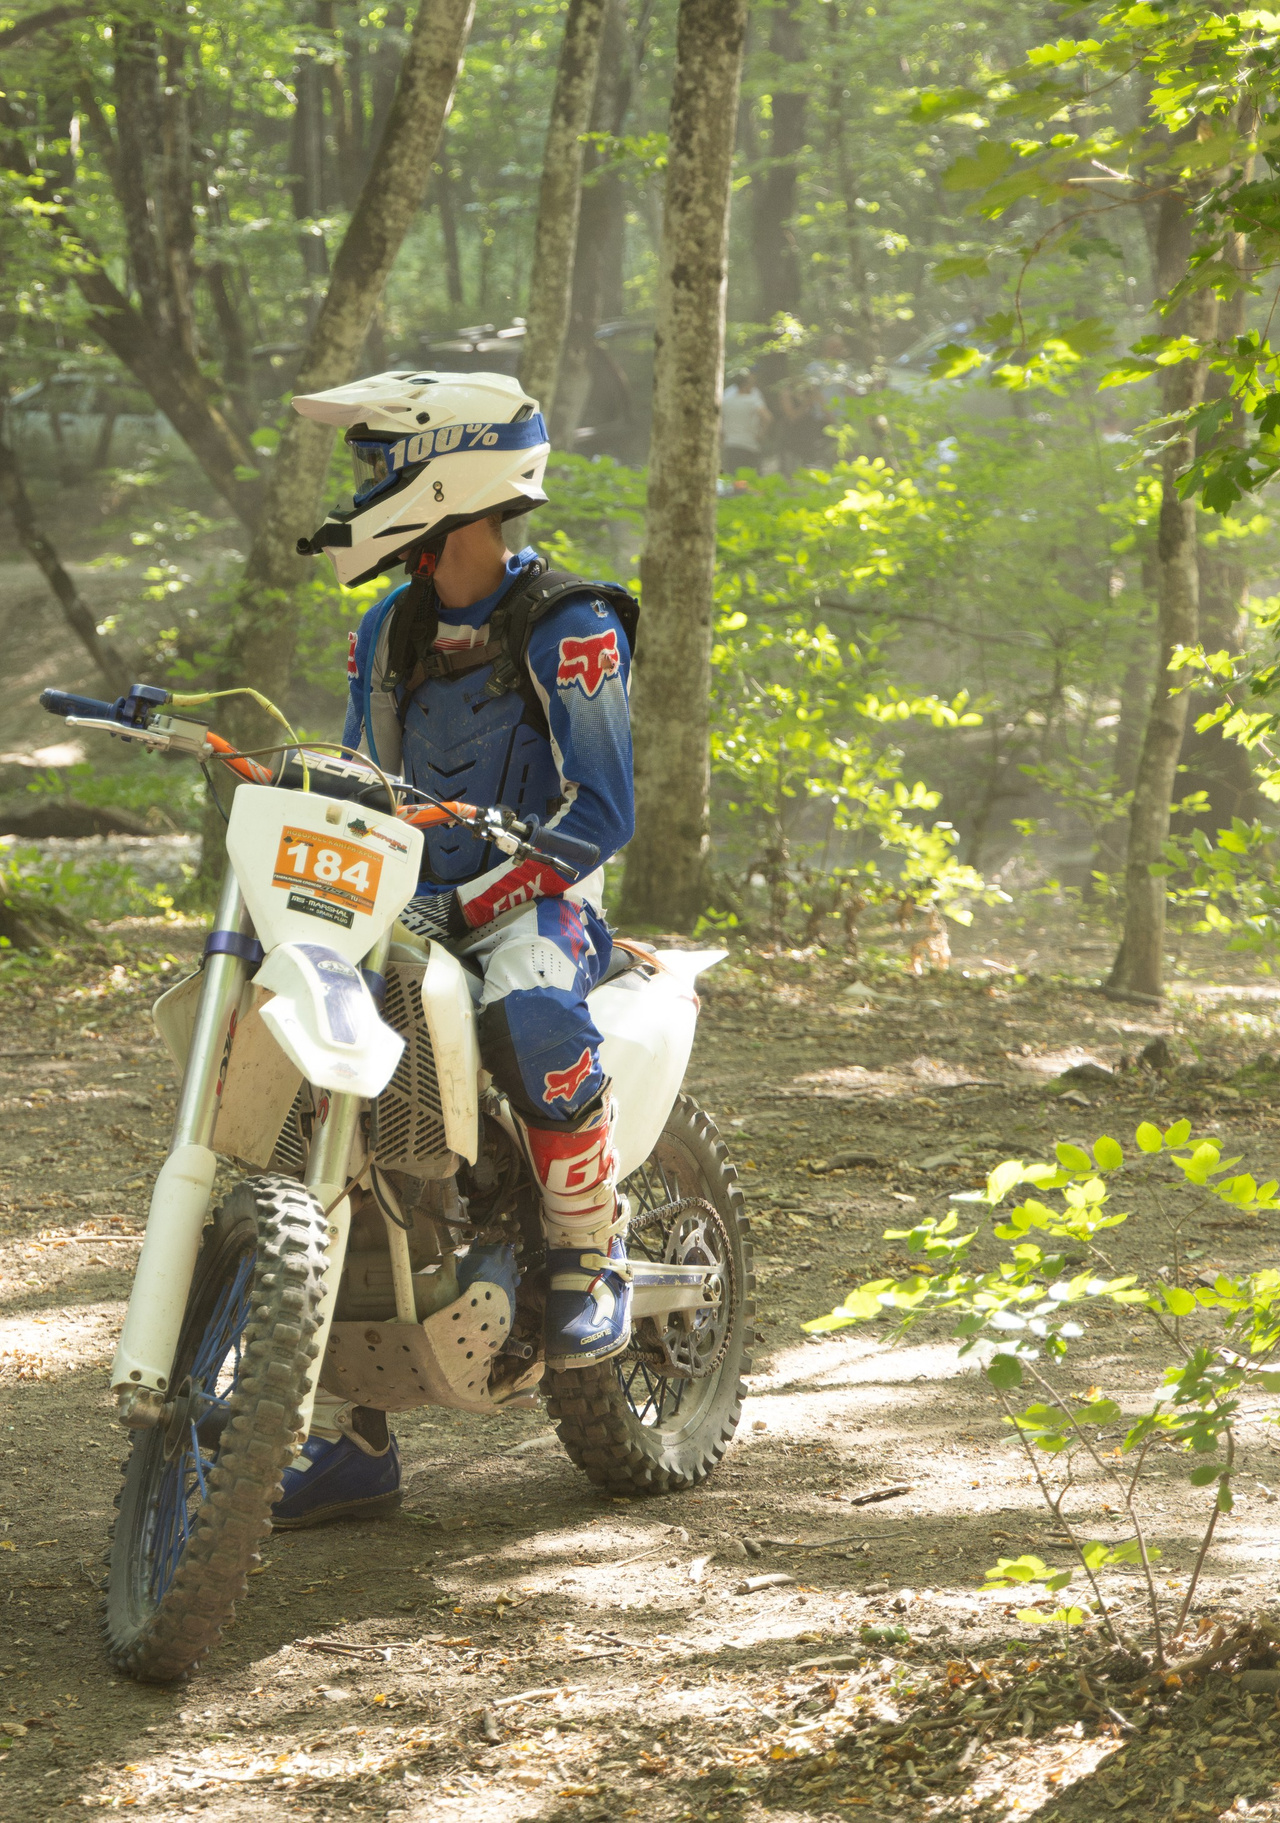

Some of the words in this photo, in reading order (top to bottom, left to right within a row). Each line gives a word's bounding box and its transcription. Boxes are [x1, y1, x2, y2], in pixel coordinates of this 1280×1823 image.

[389, 423, 499, 471] 100%
[287, 842, 370, 893] 184
[493, 873, 545, 917] FOX
